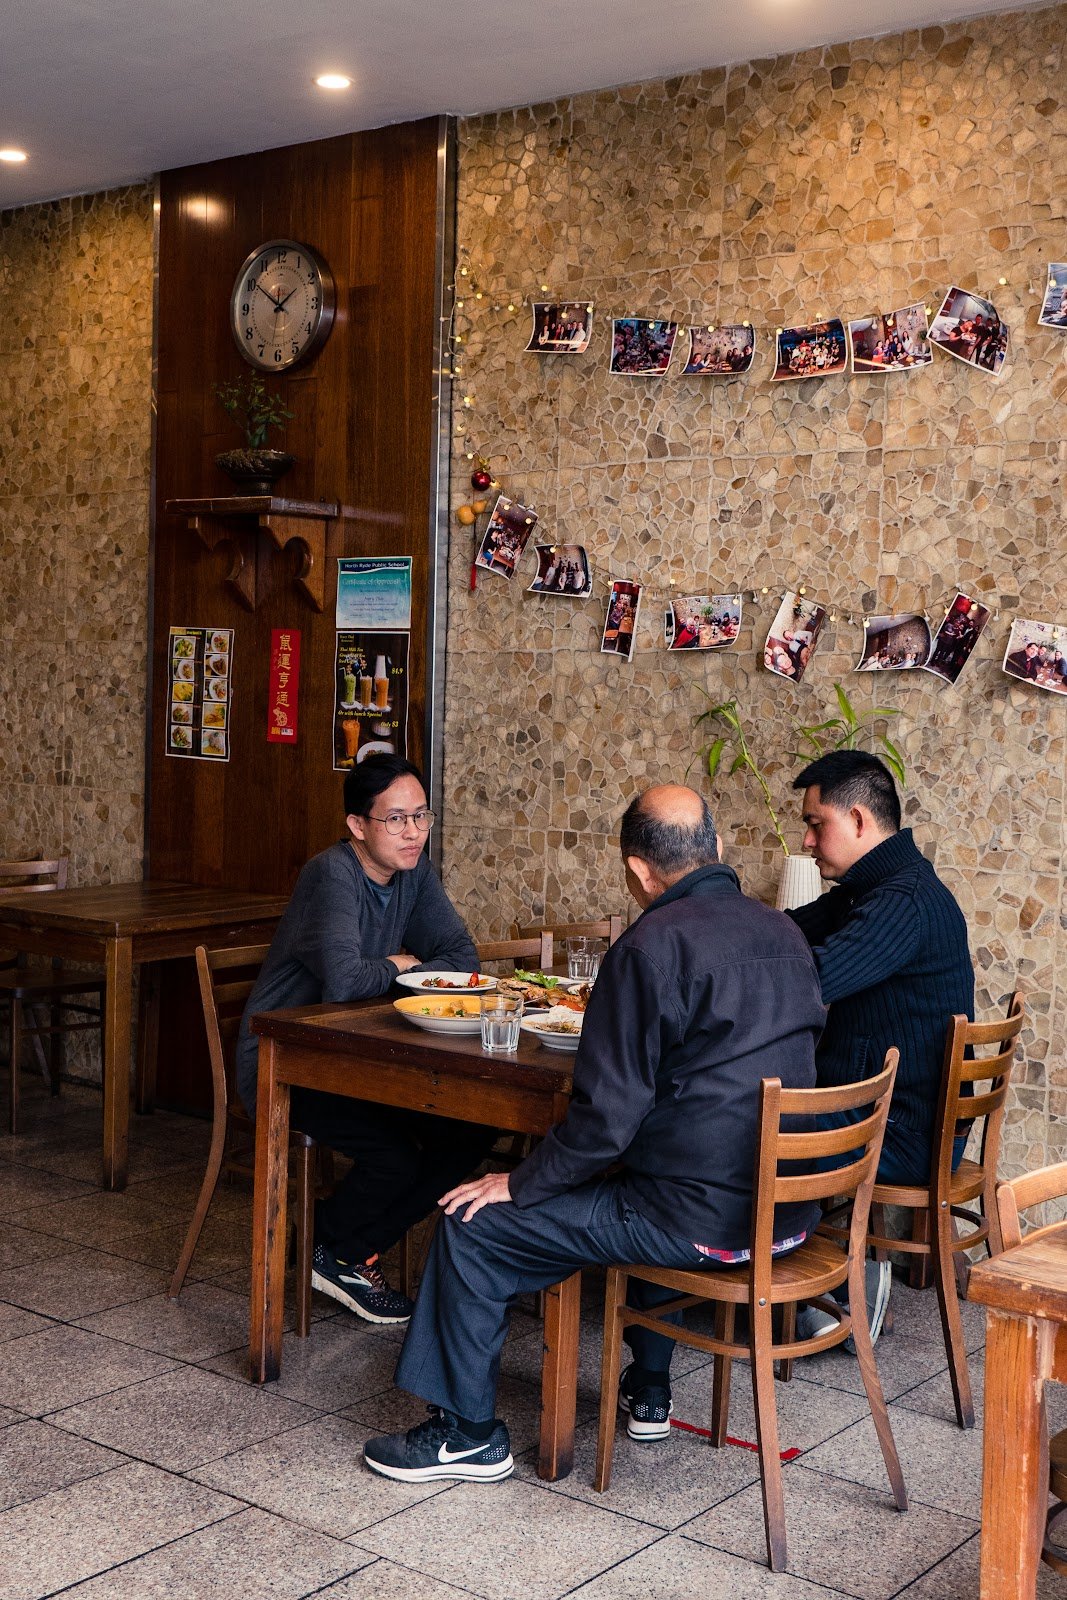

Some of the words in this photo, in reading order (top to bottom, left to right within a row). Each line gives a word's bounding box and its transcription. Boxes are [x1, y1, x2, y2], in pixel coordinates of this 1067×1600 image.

[277, 251, 287, 264] 12
[296, 256, 301, 269] 1
[261, 260, 268, 273] 11
[247, 278, 256, 292] 10
[307, 272, 315, 285] 2
[242, 303, 249, 316] 9
[311, 296, 318, 310] 3
[246, 327, 253, 340] 8
[304, 321, 311, 335] 4
[257, 344, 264, 357] 7
[291, 341, 299, 354] 5
[274, 349, 281, 362] 6
